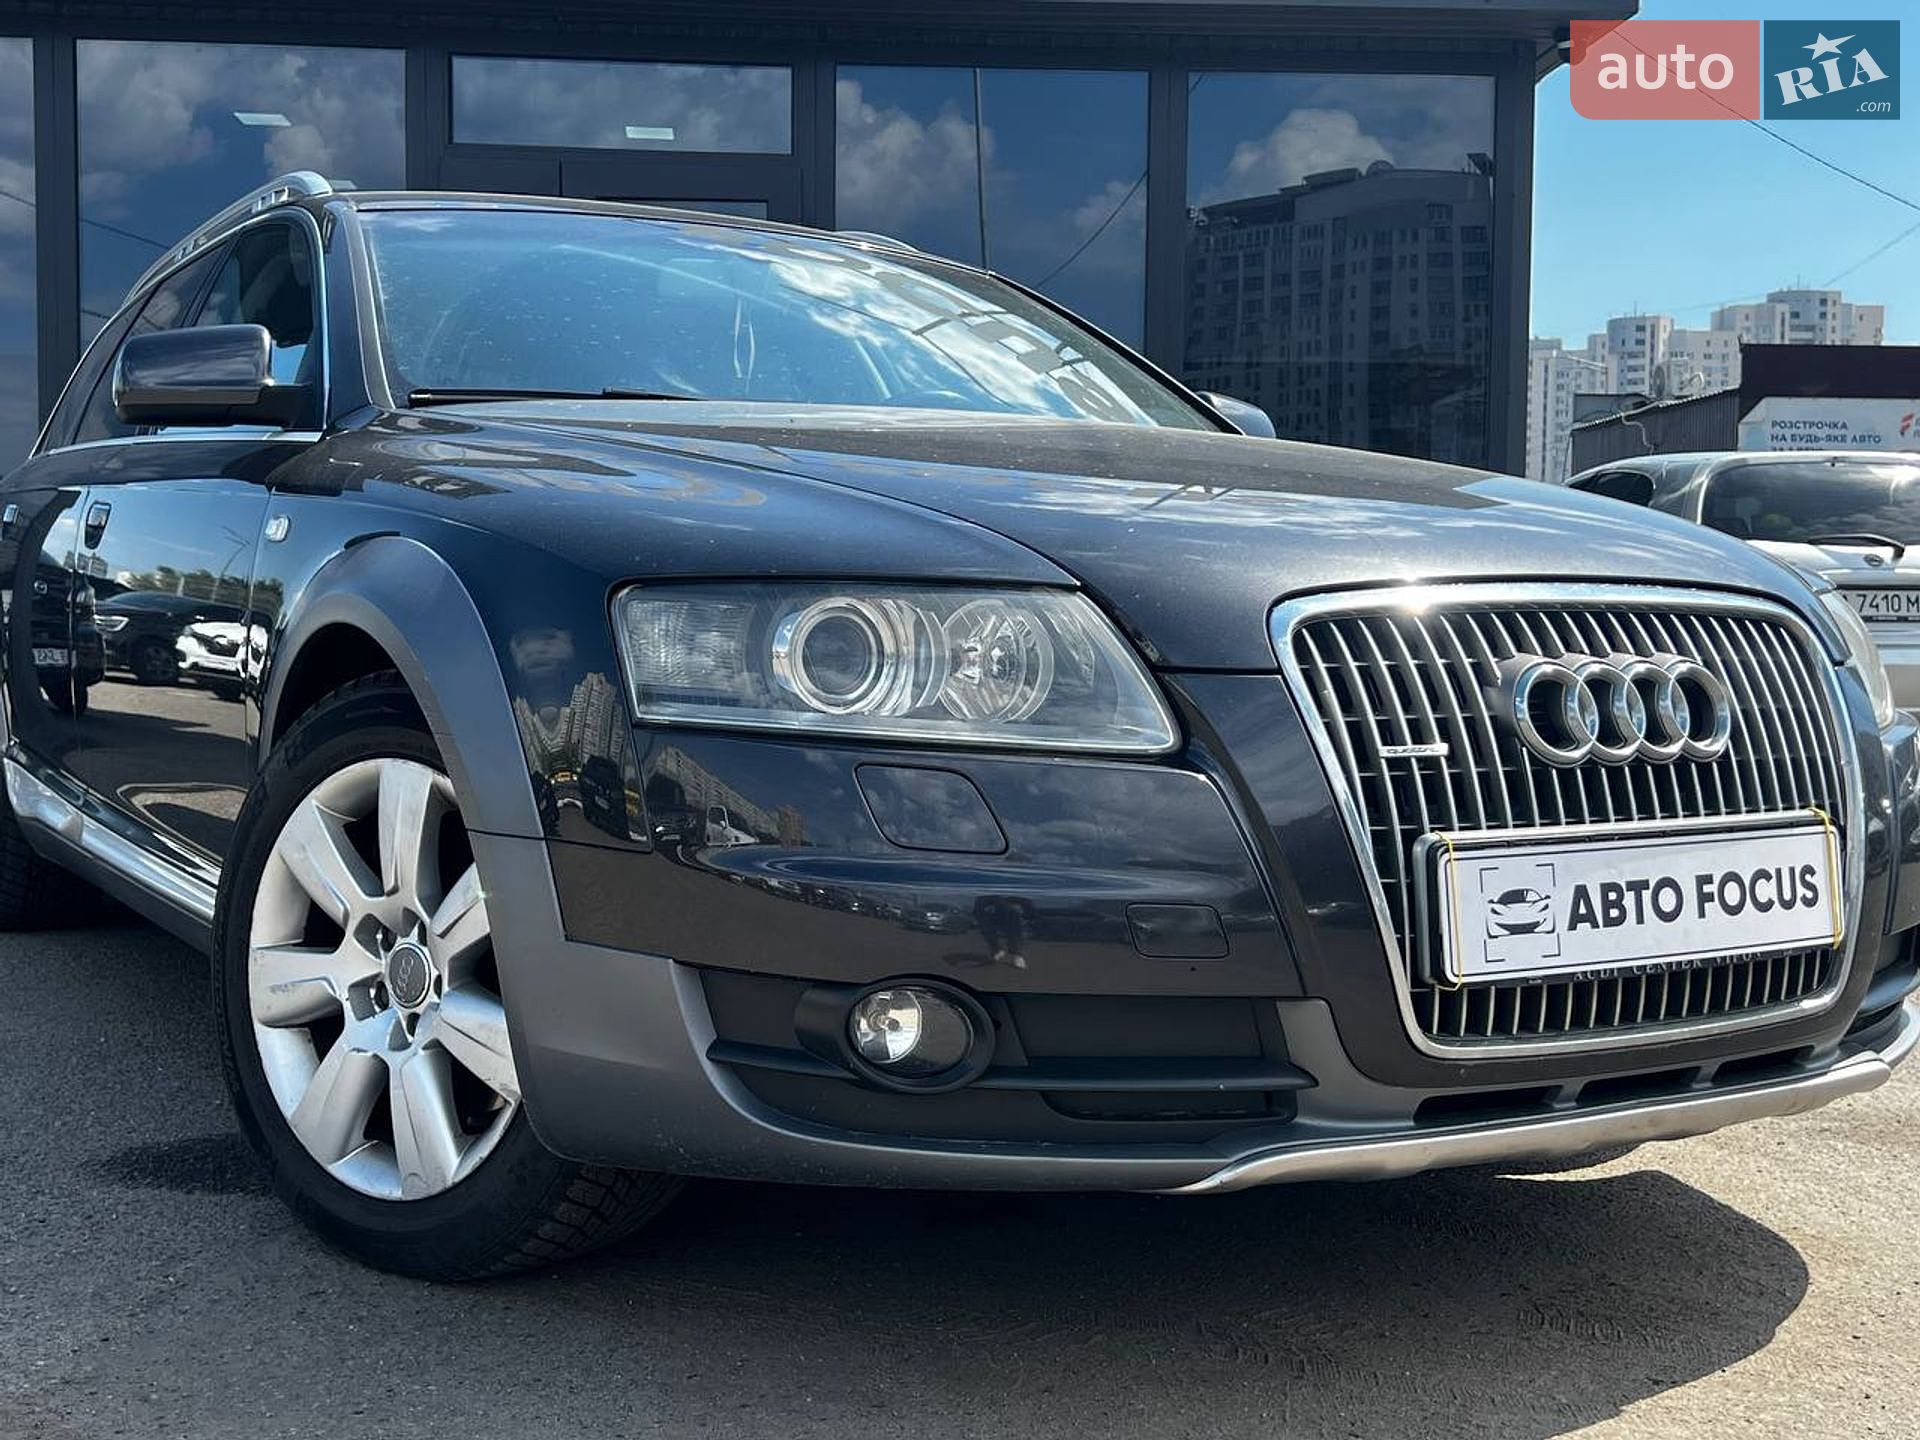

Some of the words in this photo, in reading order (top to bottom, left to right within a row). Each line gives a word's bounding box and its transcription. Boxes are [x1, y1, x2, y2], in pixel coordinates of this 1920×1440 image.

[1771, 420, 1848, 430] РОЗСТРОЧКА
[1770, 433, 1788, 443] НА
[1790, 433, 1847, 444] БУДЬ-ЯКЕ
[1851, 434, 1882, 444] АВТО
[1856, 594, 1901, 613] 7410
[1695, 864, 1820, 920] FOCUS
